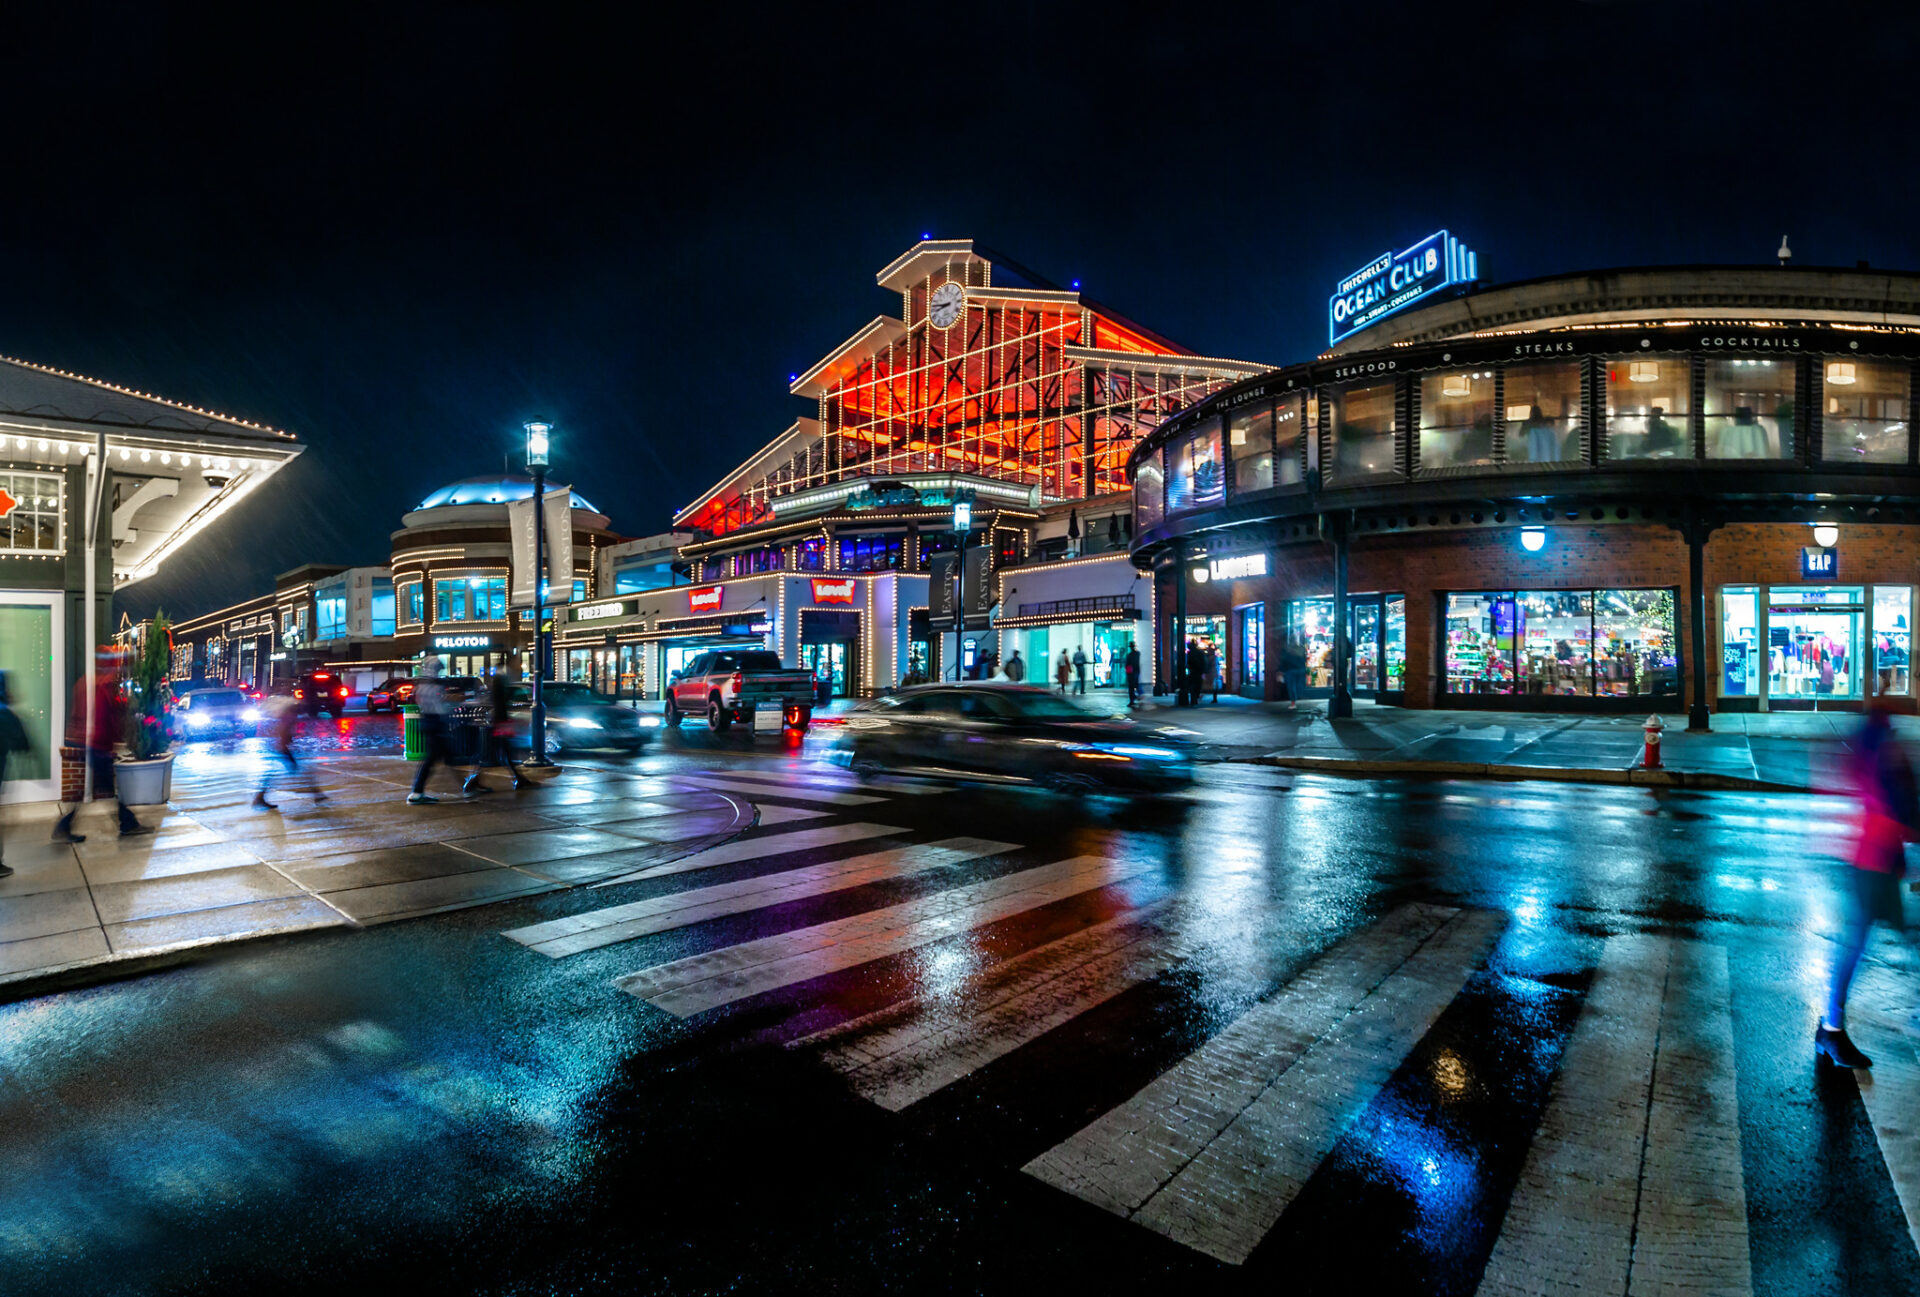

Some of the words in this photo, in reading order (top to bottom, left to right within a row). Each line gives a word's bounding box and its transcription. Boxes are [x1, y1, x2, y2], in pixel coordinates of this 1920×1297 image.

[1334, 277, 1385, 322] OCEAN
[1389, 248, 1437, 291] CLUB
[1342, 258, 1388, 293] MITCHELL'S
[1514, 342, 1574, 355] STEAKS
[1701, 336, 1800, 348] COCKTAILS
[1335, 360, 1397, 378] SEAFOOD
[1216, 399, 1229, 409] THE
[1233, 386, 1265, 404] LOUNGE
[526, 513, 535, 585] EASTON
[561, 506, 571, 580] EASTON
[1808, 554, 1831, 570] GAP
[942, 560, 954, 614] EASTON
[977, 556, 989, 611] EASTON
[435, 636, 489, 648] PELOTON
